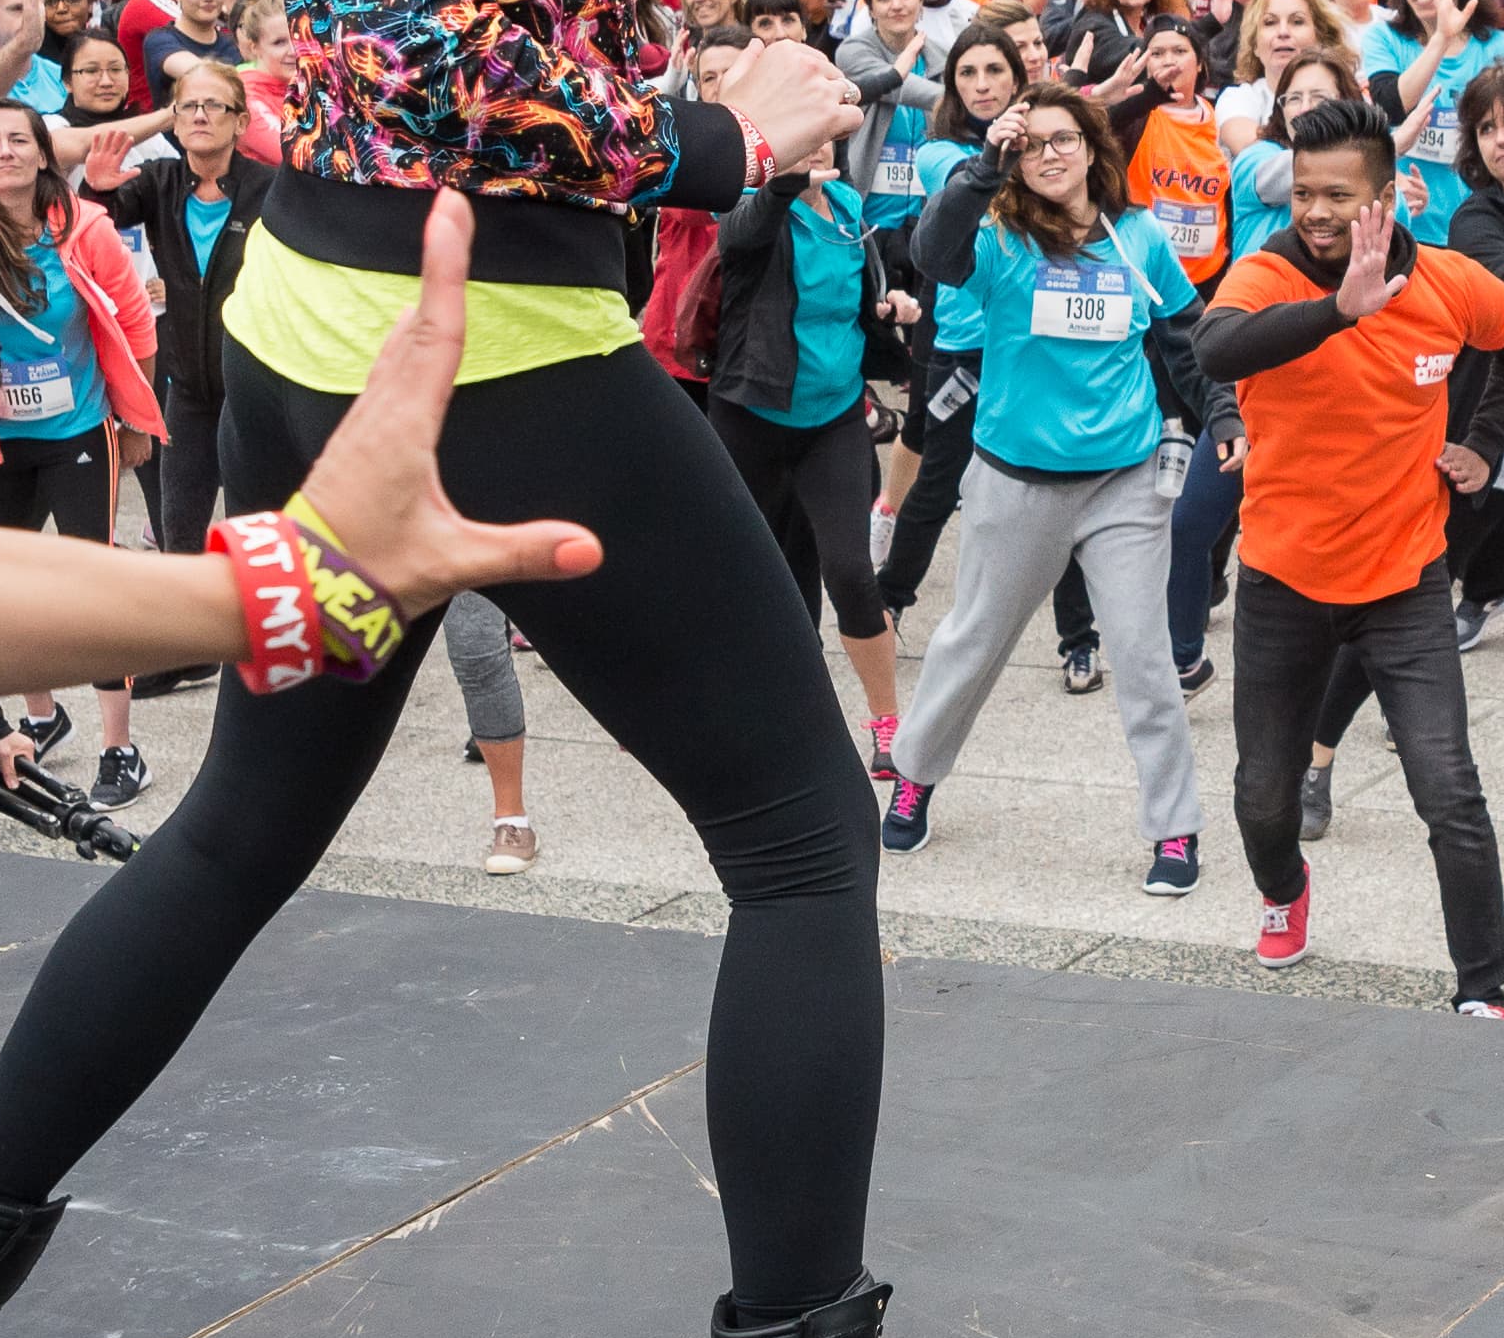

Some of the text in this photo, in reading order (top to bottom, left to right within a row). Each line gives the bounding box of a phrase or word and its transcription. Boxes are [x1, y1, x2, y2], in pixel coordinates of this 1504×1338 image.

[1151, 168, 1220, 195] KPMG
[1171, 226, 1200, 244] 2316
[1066, 296, 1105, 321] 1308
[6, 387, 43, 406] 1166
[256, 586, 311, 654] MY
